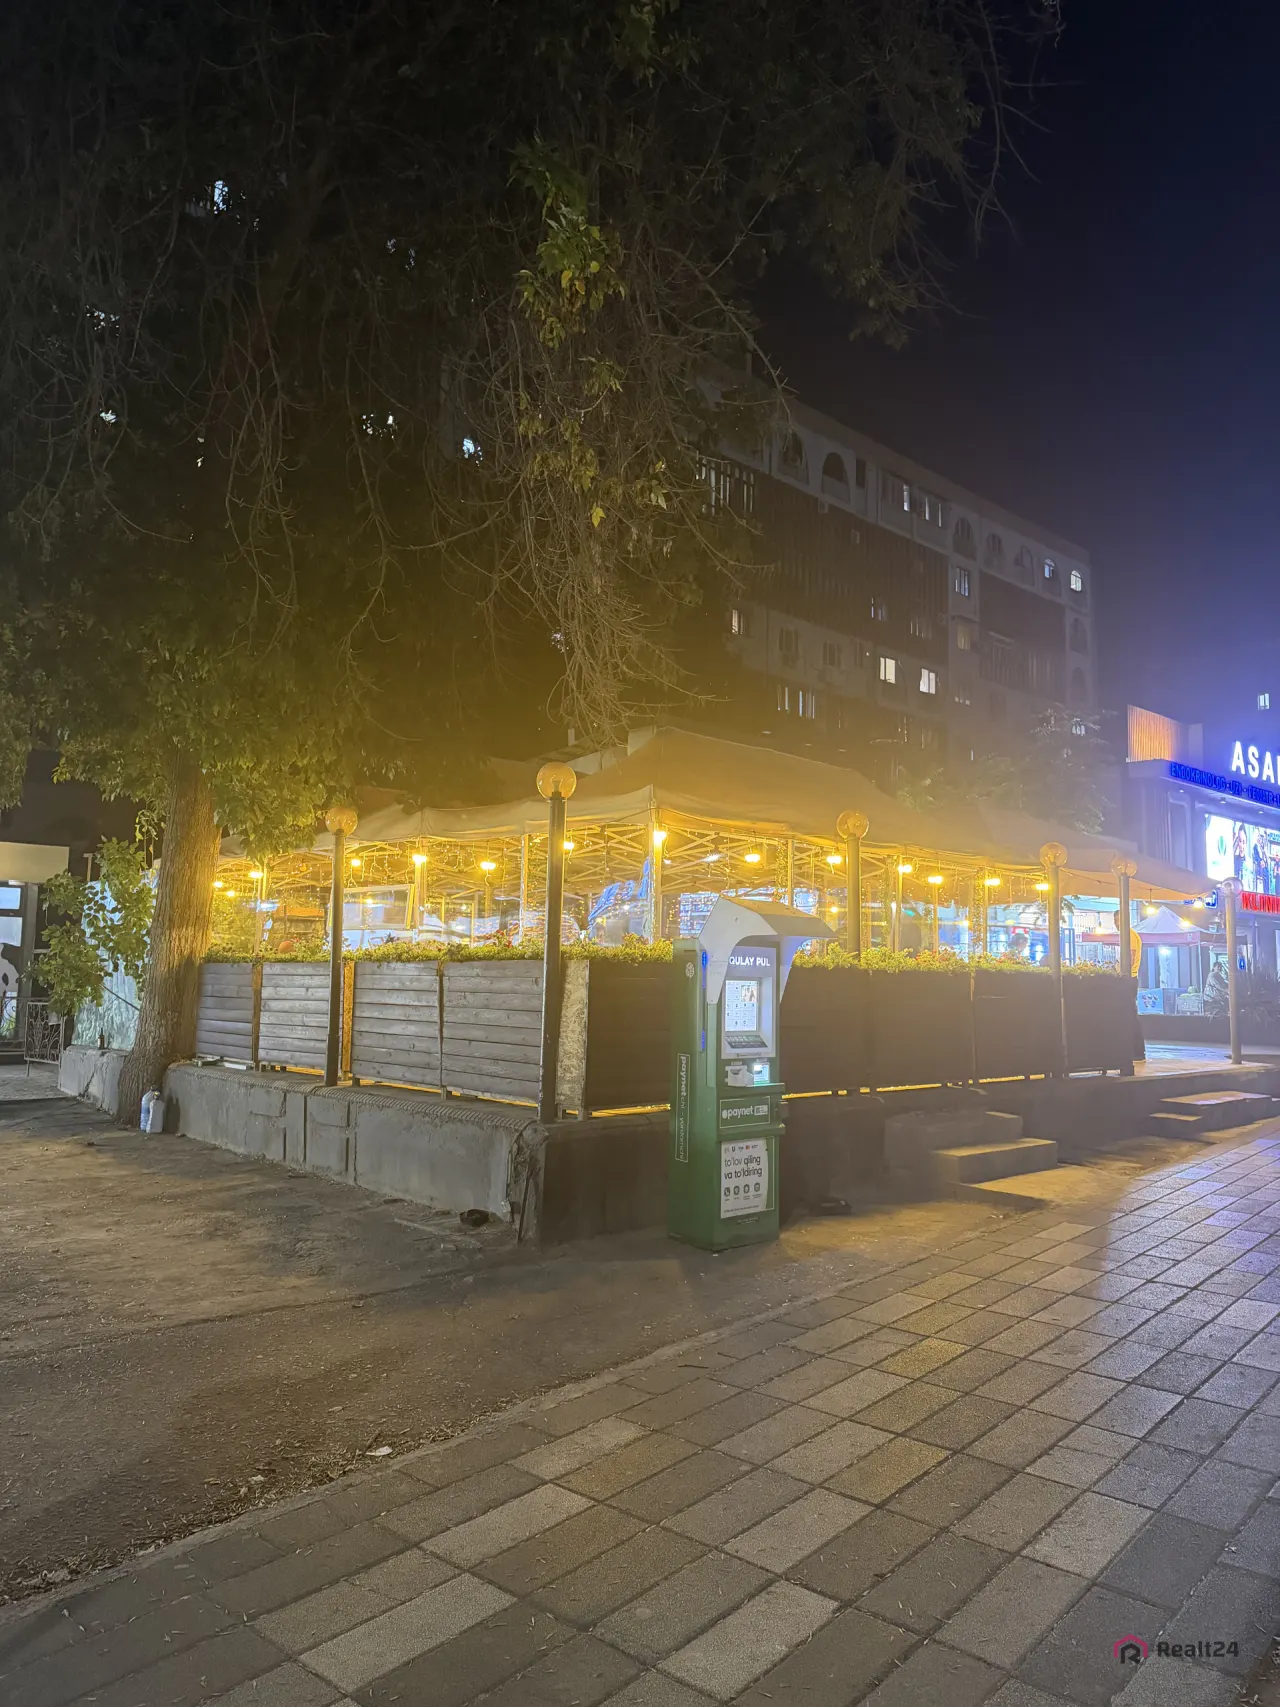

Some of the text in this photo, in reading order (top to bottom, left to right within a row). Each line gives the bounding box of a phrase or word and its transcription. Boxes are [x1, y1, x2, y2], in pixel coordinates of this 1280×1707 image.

[1231, 740, 1280, 785] ASA
[1241, 891, 1280, 915] KLINI
[729, 956, 770, 967] QULAY PUL
[727, 1105, 753, 1120] paynet
